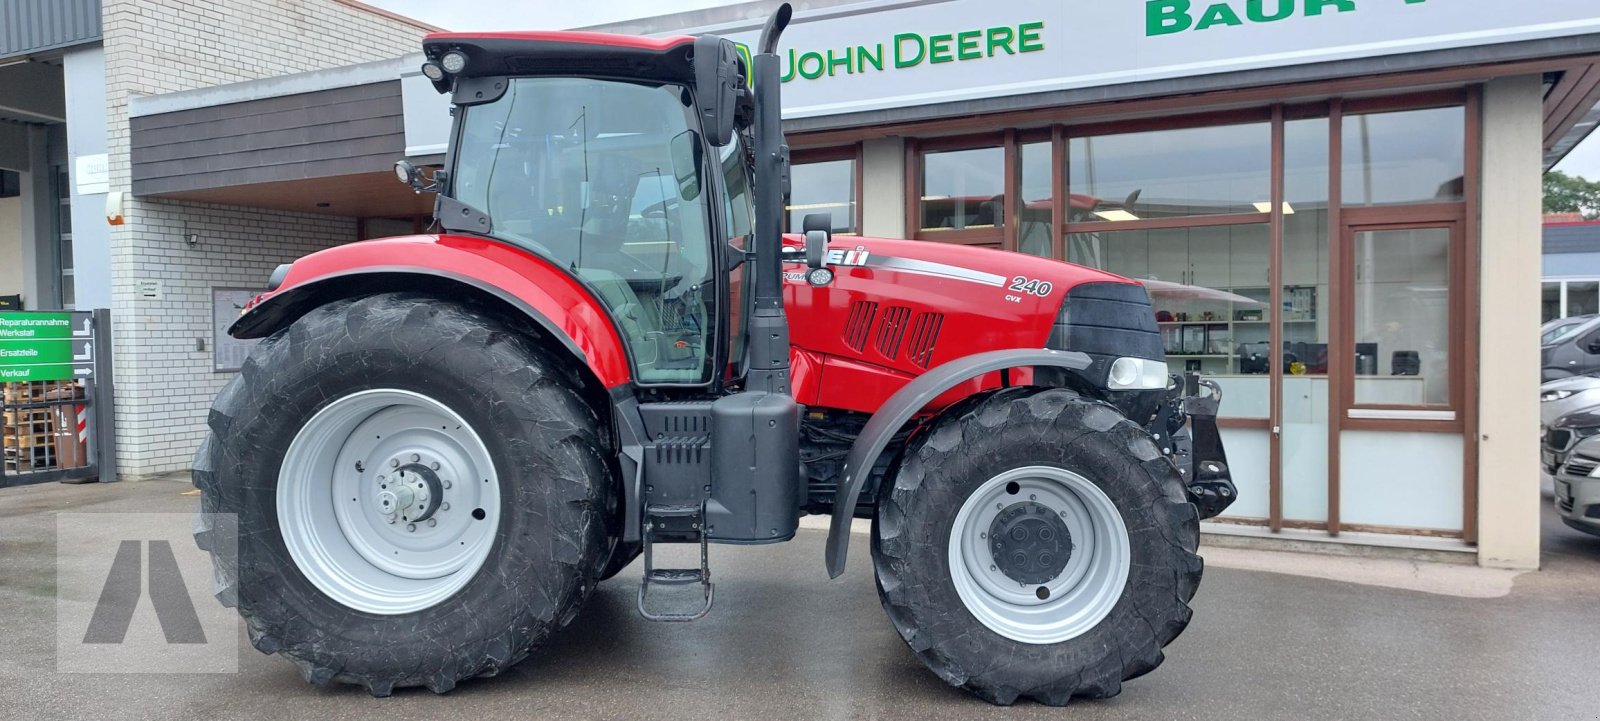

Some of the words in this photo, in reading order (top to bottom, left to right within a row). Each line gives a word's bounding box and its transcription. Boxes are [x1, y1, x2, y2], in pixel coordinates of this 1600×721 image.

[781, 43, 885, 83] JOHN
[894, 21, 1045, 69] DEERE
[1008, 275, 1053, 297] 240
[1005, 294, 1022, 303] CVX
[0, 318, 70, 327] Reparaturannahme
[0, 329, 35, 337] Werkstatt
[0, 348, 39, 358] Ersatzteile
[1, 368, 31, 378] Verkauf
